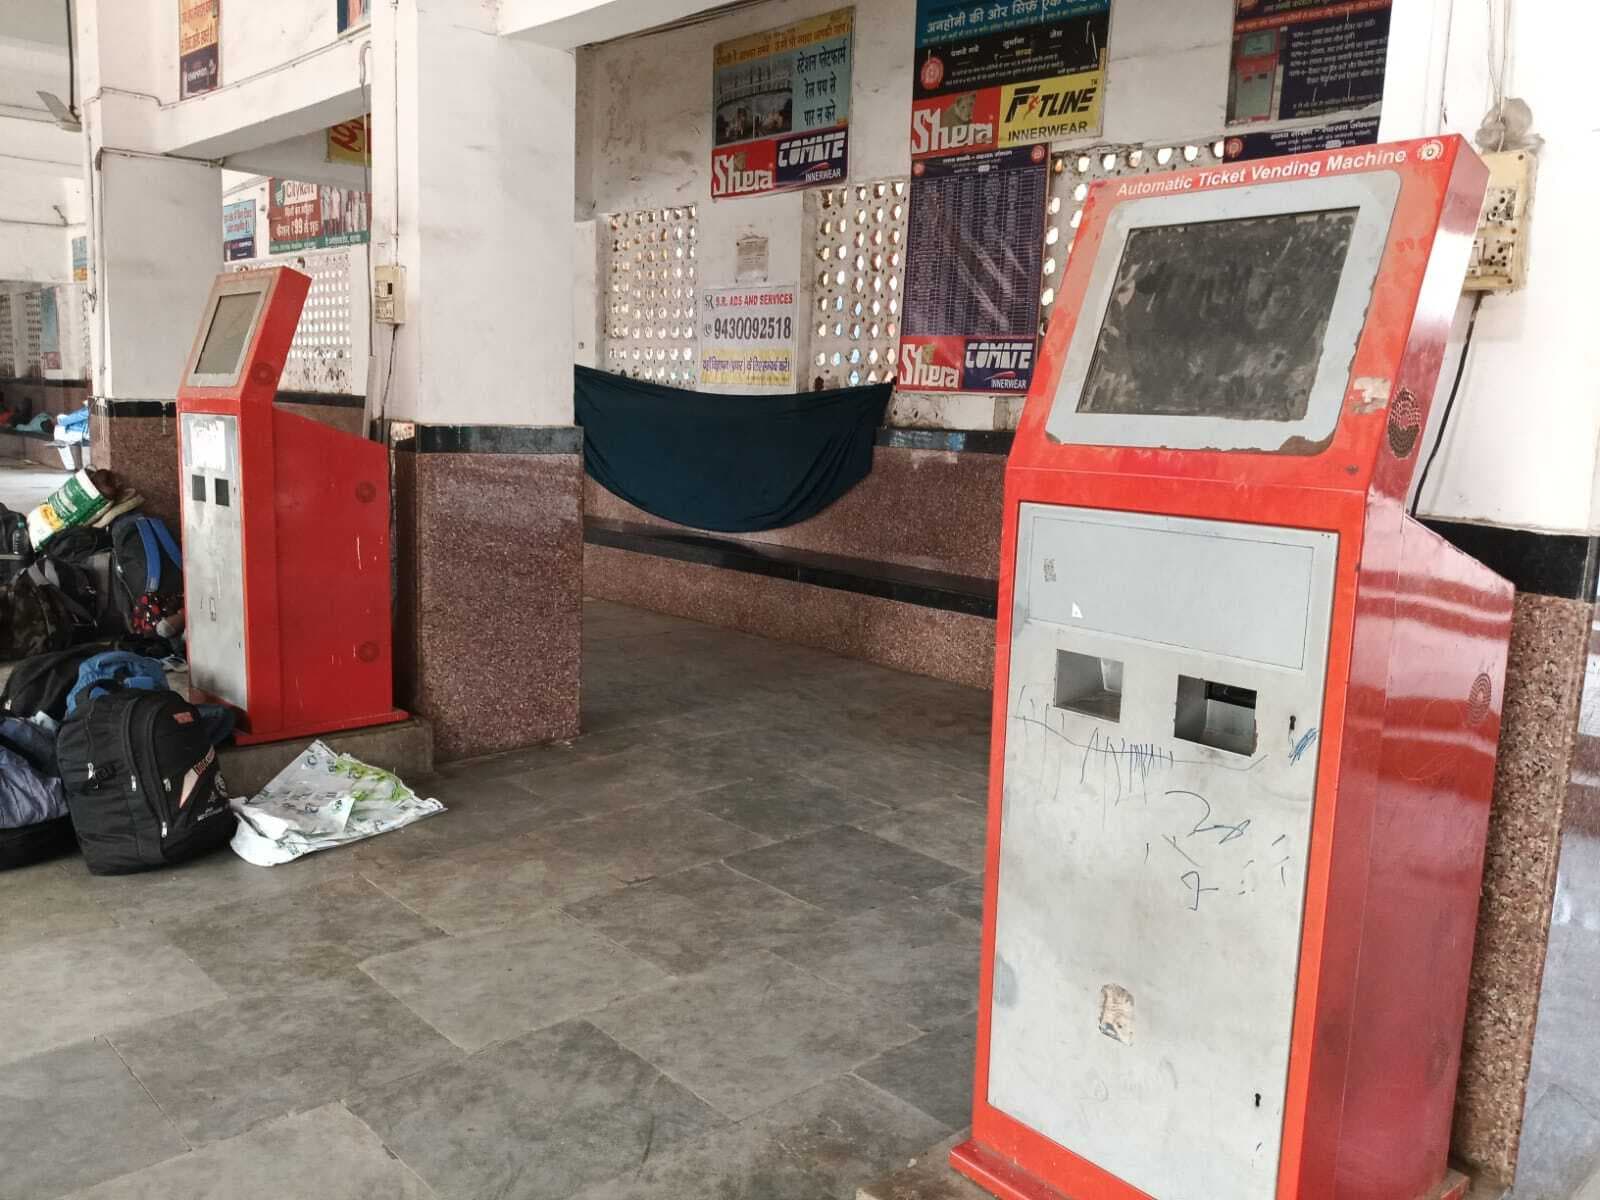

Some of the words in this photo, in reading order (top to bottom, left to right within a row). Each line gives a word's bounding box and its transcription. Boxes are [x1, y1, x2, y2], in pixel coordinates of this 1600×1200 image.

[926, 13, 966, 33] अनहोनी
[970, 9, 983, 24] की
[987, 5, 1008, 21] ओर
[804, 78, 816, 99] रेल
[830, 71, 838, 93] से
[804, 108, 816, 127] पार
[817, 106, 824, 124] न
[912, 108, 993, 154] Shera
[1008, 120, 1088, 142] INNERWEAR
[778, 132, 845, 168] COMATE
[712, 154, 774, 196] Shera
[805, 168, 841, 182] INNERWEAR
[1117, 178, 1192, 197] Automatic
[1199, 168, 1246, 187] Ticket
[1252, 160, 1321, 180] Vending
[1326, 150, 1407, 172] Machine
[730, 295, 743, 306] ADS
[744, 294, 758, 306] AND
[760, 292, 793, 305] SERVICES
[714, 316, 792, 340] 9430092518
[900, 343, 960, 388] Shera
[965, 342, 1033, 369] COMATE
[991, 379, 1027, 389] INNERWEAR
